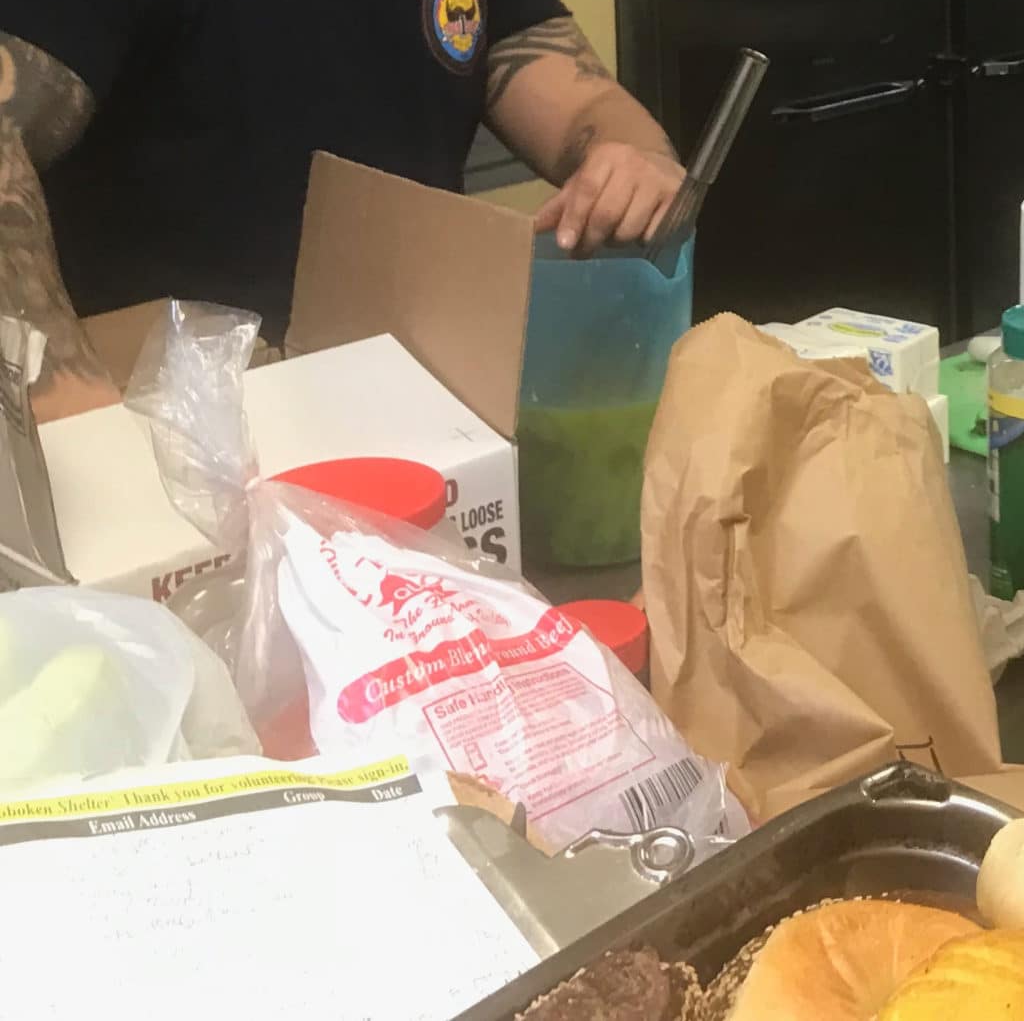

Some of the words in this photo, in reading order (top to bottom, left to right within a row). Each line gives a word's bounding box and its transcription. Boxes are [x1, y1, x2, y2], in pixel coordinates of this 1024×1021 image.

[461, 499, 504, 533] LOOSE
[393, 606, 424, 629] The
[364, 660, 446, 704] Custom
[448, 641, 489, 668] Blen
[537, 614, 574, 648] Beef
[433, 697, 468, 720] Safe
[123, 789, 170, 806] Thank
[174, 785, 201, 802] you
[203, 781, 225, 796] for
[282, 790, 326, 805] Group
[369, 785, 404, 802] Date
[88, 814, 136, 835] Email
[138, 809, 197, 828] Address
